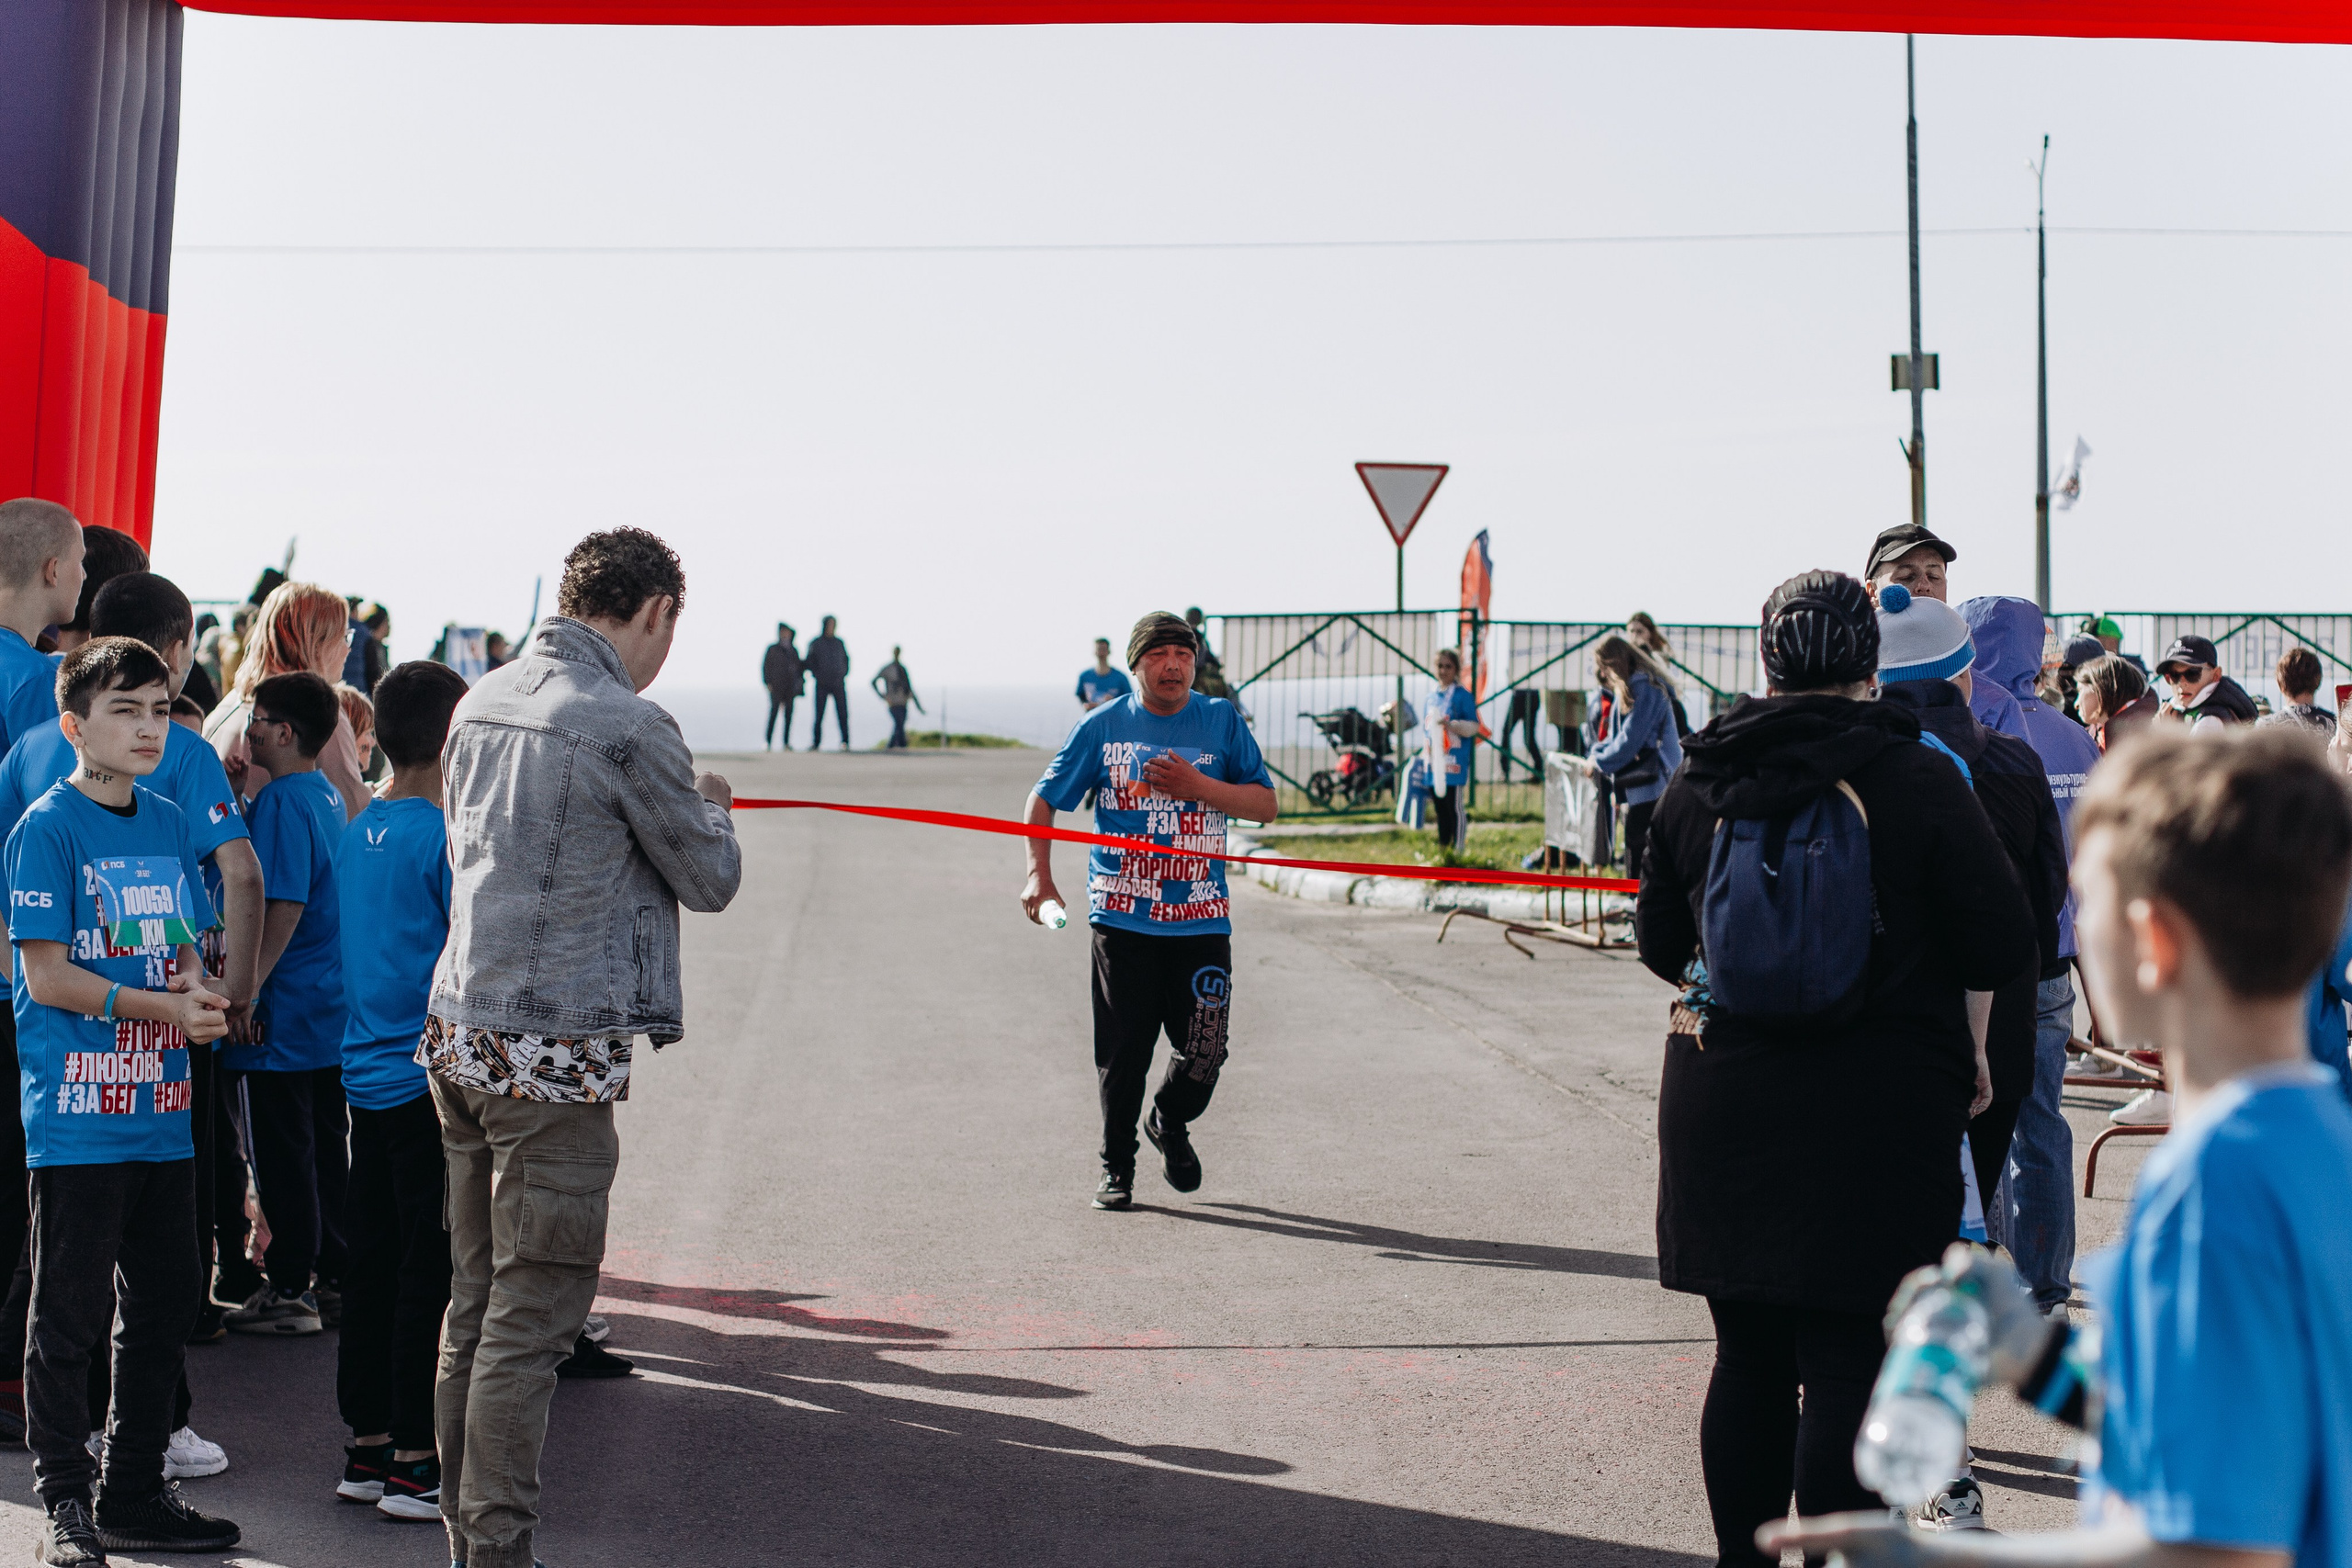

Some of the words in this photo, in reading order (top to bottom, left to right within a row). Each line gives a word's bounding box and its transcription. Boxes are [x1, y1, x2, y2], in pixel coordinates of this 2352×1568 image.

[1103, 742, 1133, 766] 202
[2052, 785, 2069, 798] ьный
[110, 861, 125, 869] ПСБ
[1118, 856, 1210, 881] #ГОРДОСТЬ
[1091, 874, 1162, 901] ЛЮБОВЬ
[1187, 881, 1222, 903] 2024
[121, 885, 174, 916] 10059
[64, 1053, 164, 1083] #ЛЮБОВЬ
[57, 1084, 137, 1114] #ЗАБЕГ
